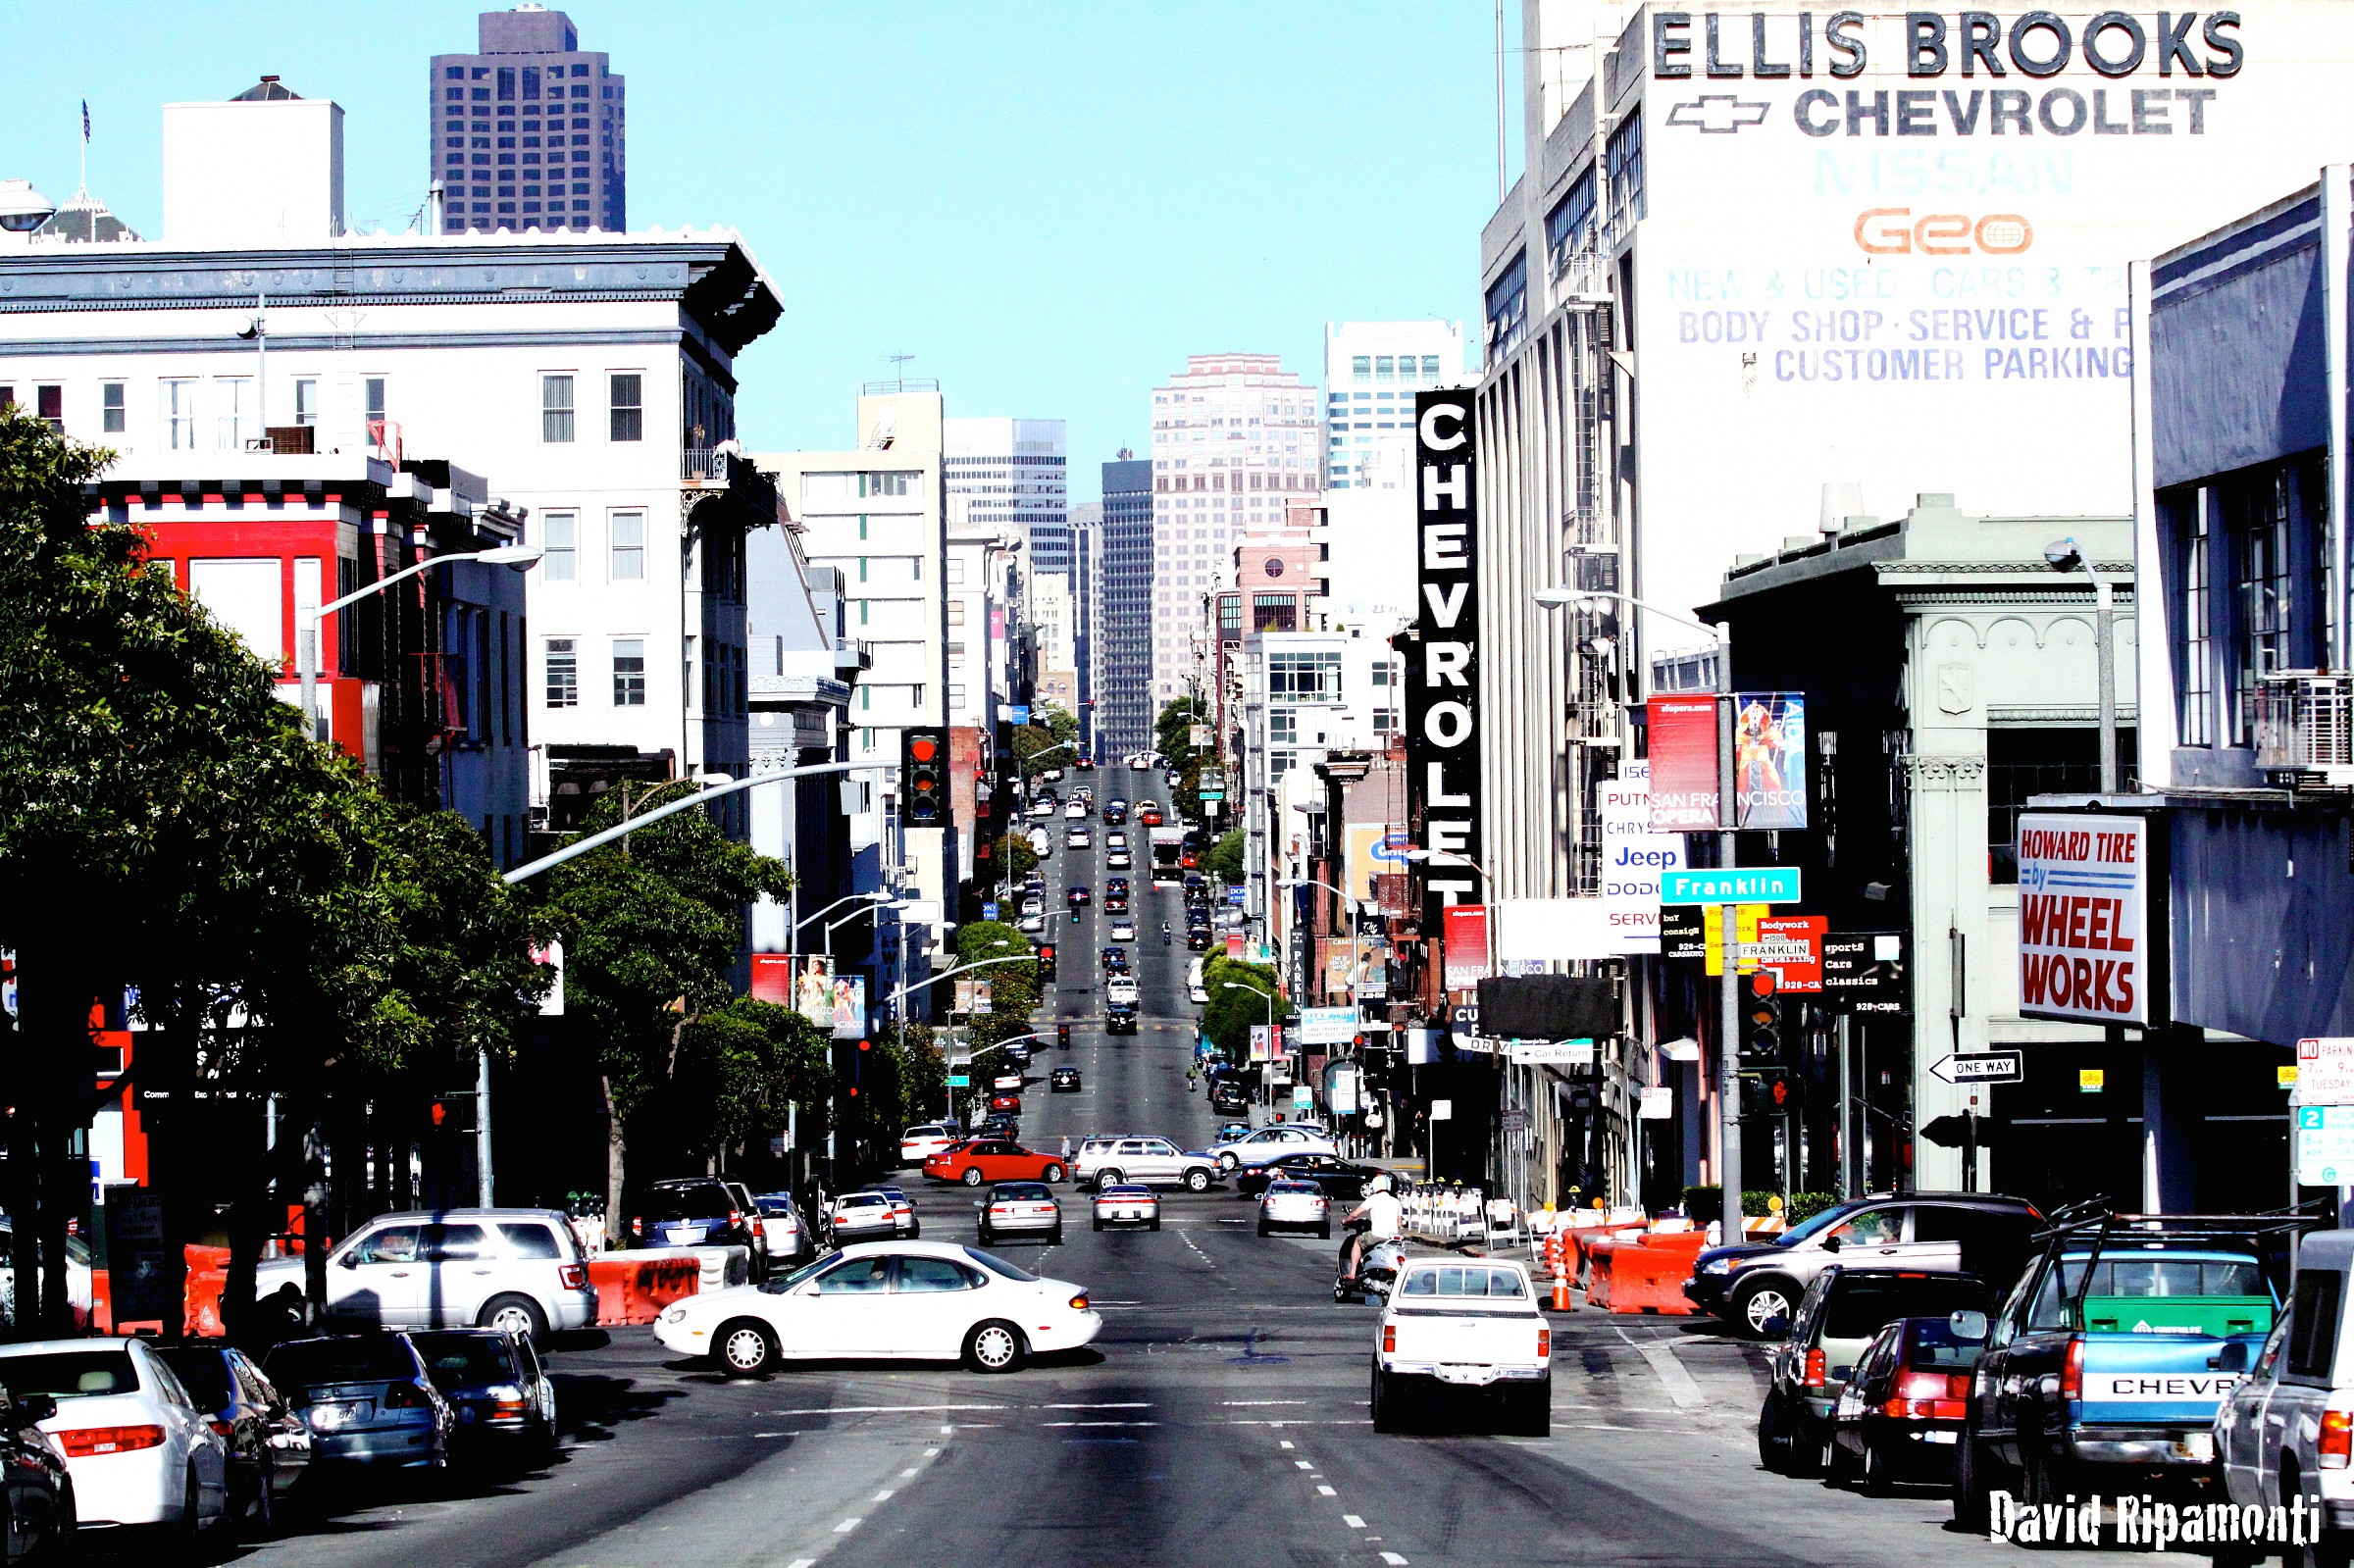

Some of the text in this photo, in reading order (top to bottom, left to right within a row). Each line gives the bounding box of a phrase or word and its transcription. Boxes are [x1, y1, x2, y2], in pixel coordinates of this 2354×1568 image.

[1653, 10, 2245, 78] ELLIS BROOKS
[1794, 88, 2217, 136] CHEVROLET
[1813, 148, 2076, 197] NISSAN
[1667, 269, 1747, 301] NEW
[1803, 267, 1899, 301] USED
[1932, 266, 2026, 300] CARS
[1678, 311, 1768, 343] BODY
[1791, 309, 1883, 343] SHOP
[1909, 308, 2049, 342] SERVICE
[1774, 346, 2131, 382] CUSTOMER PARKING
[1419, 402, 1473, 907] CHEVROLET
[1651, 792, 1687, 808] SAN
[1651, 808, 1715, 825] OPERA
[1614, 846, 1677, 871] Jeep
[2021, 830, 2136, 863] HOWARD TIRE
[1675, 877, 1784, 896] Franklin
[2031, 863, 2047, 891] by
[1760, 920, 1811, 931] Bodywork
[2021, 894, 2134, 952] WHEEL
[1742, 944, 1808, 956] FRANKLIN
[1824, 976, 1878, 986] classics
[2021, 953, 2134, 1013] WORKS
[1856, 1002, 1901, 1011] 928-CARS
[2301, 1041, 2317, 1058] NO
[1956, 1061, 2011, 1074] ONE WAY
[2311, 1079, 2351, 1089] TUESDAY
[2305, 1110, 2320, 1127] 2
